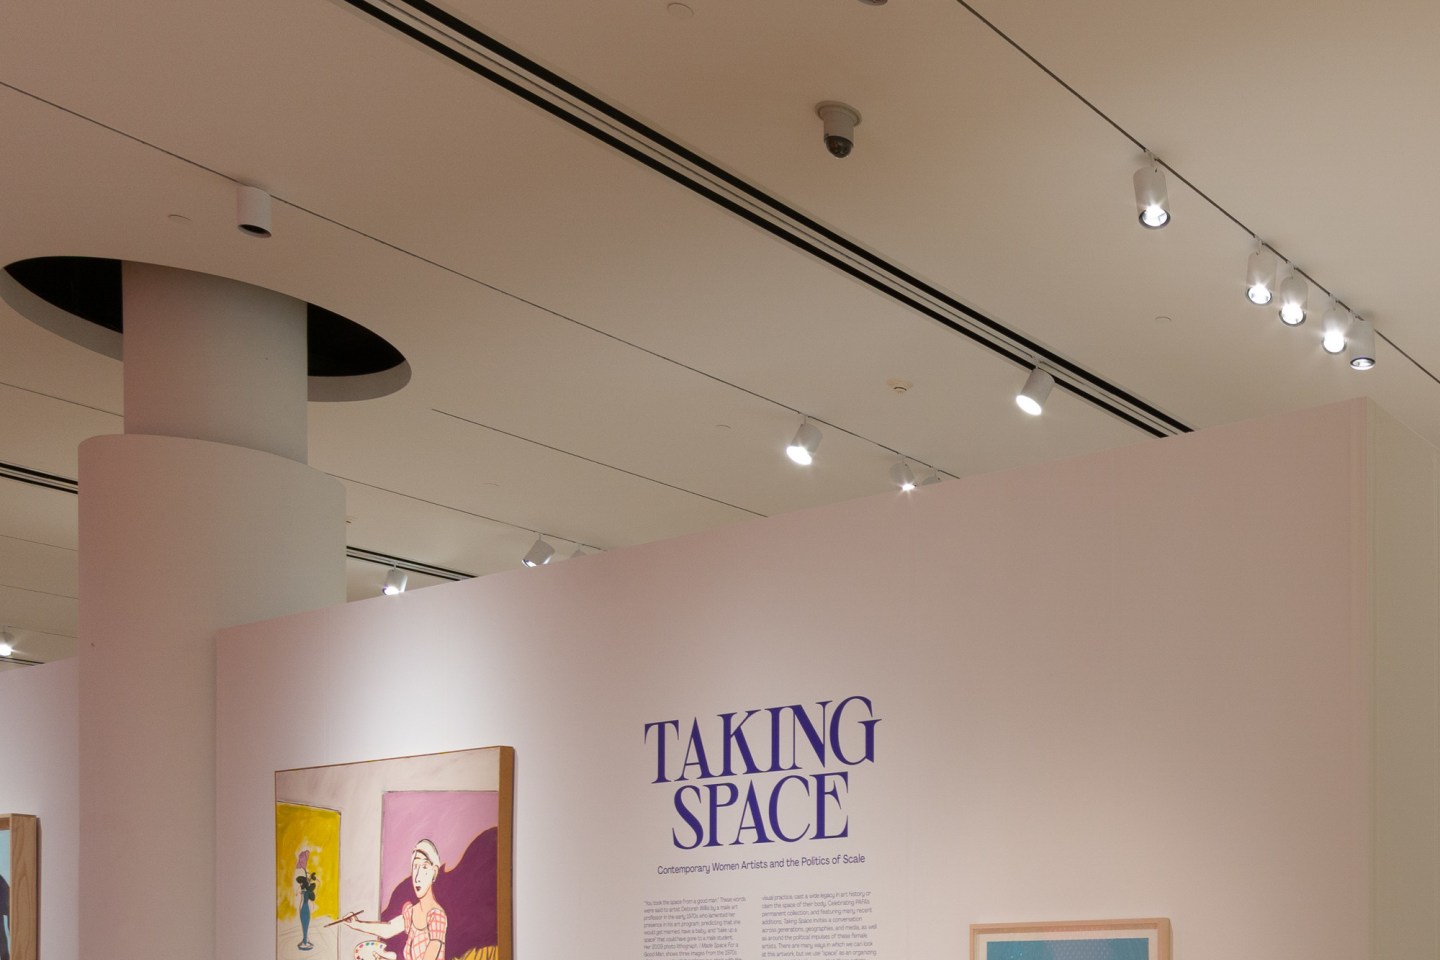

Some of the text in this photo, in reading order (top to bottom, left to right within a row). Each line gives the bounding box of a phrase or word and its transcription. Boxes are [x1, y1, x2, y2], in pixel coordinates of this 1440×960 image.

[644, 695, 882, 784] TAKING
[672, 771, 849, 850] SPACE
[657, 853, 865, 877] Contemporary Women Artists and the Politics of Scale
